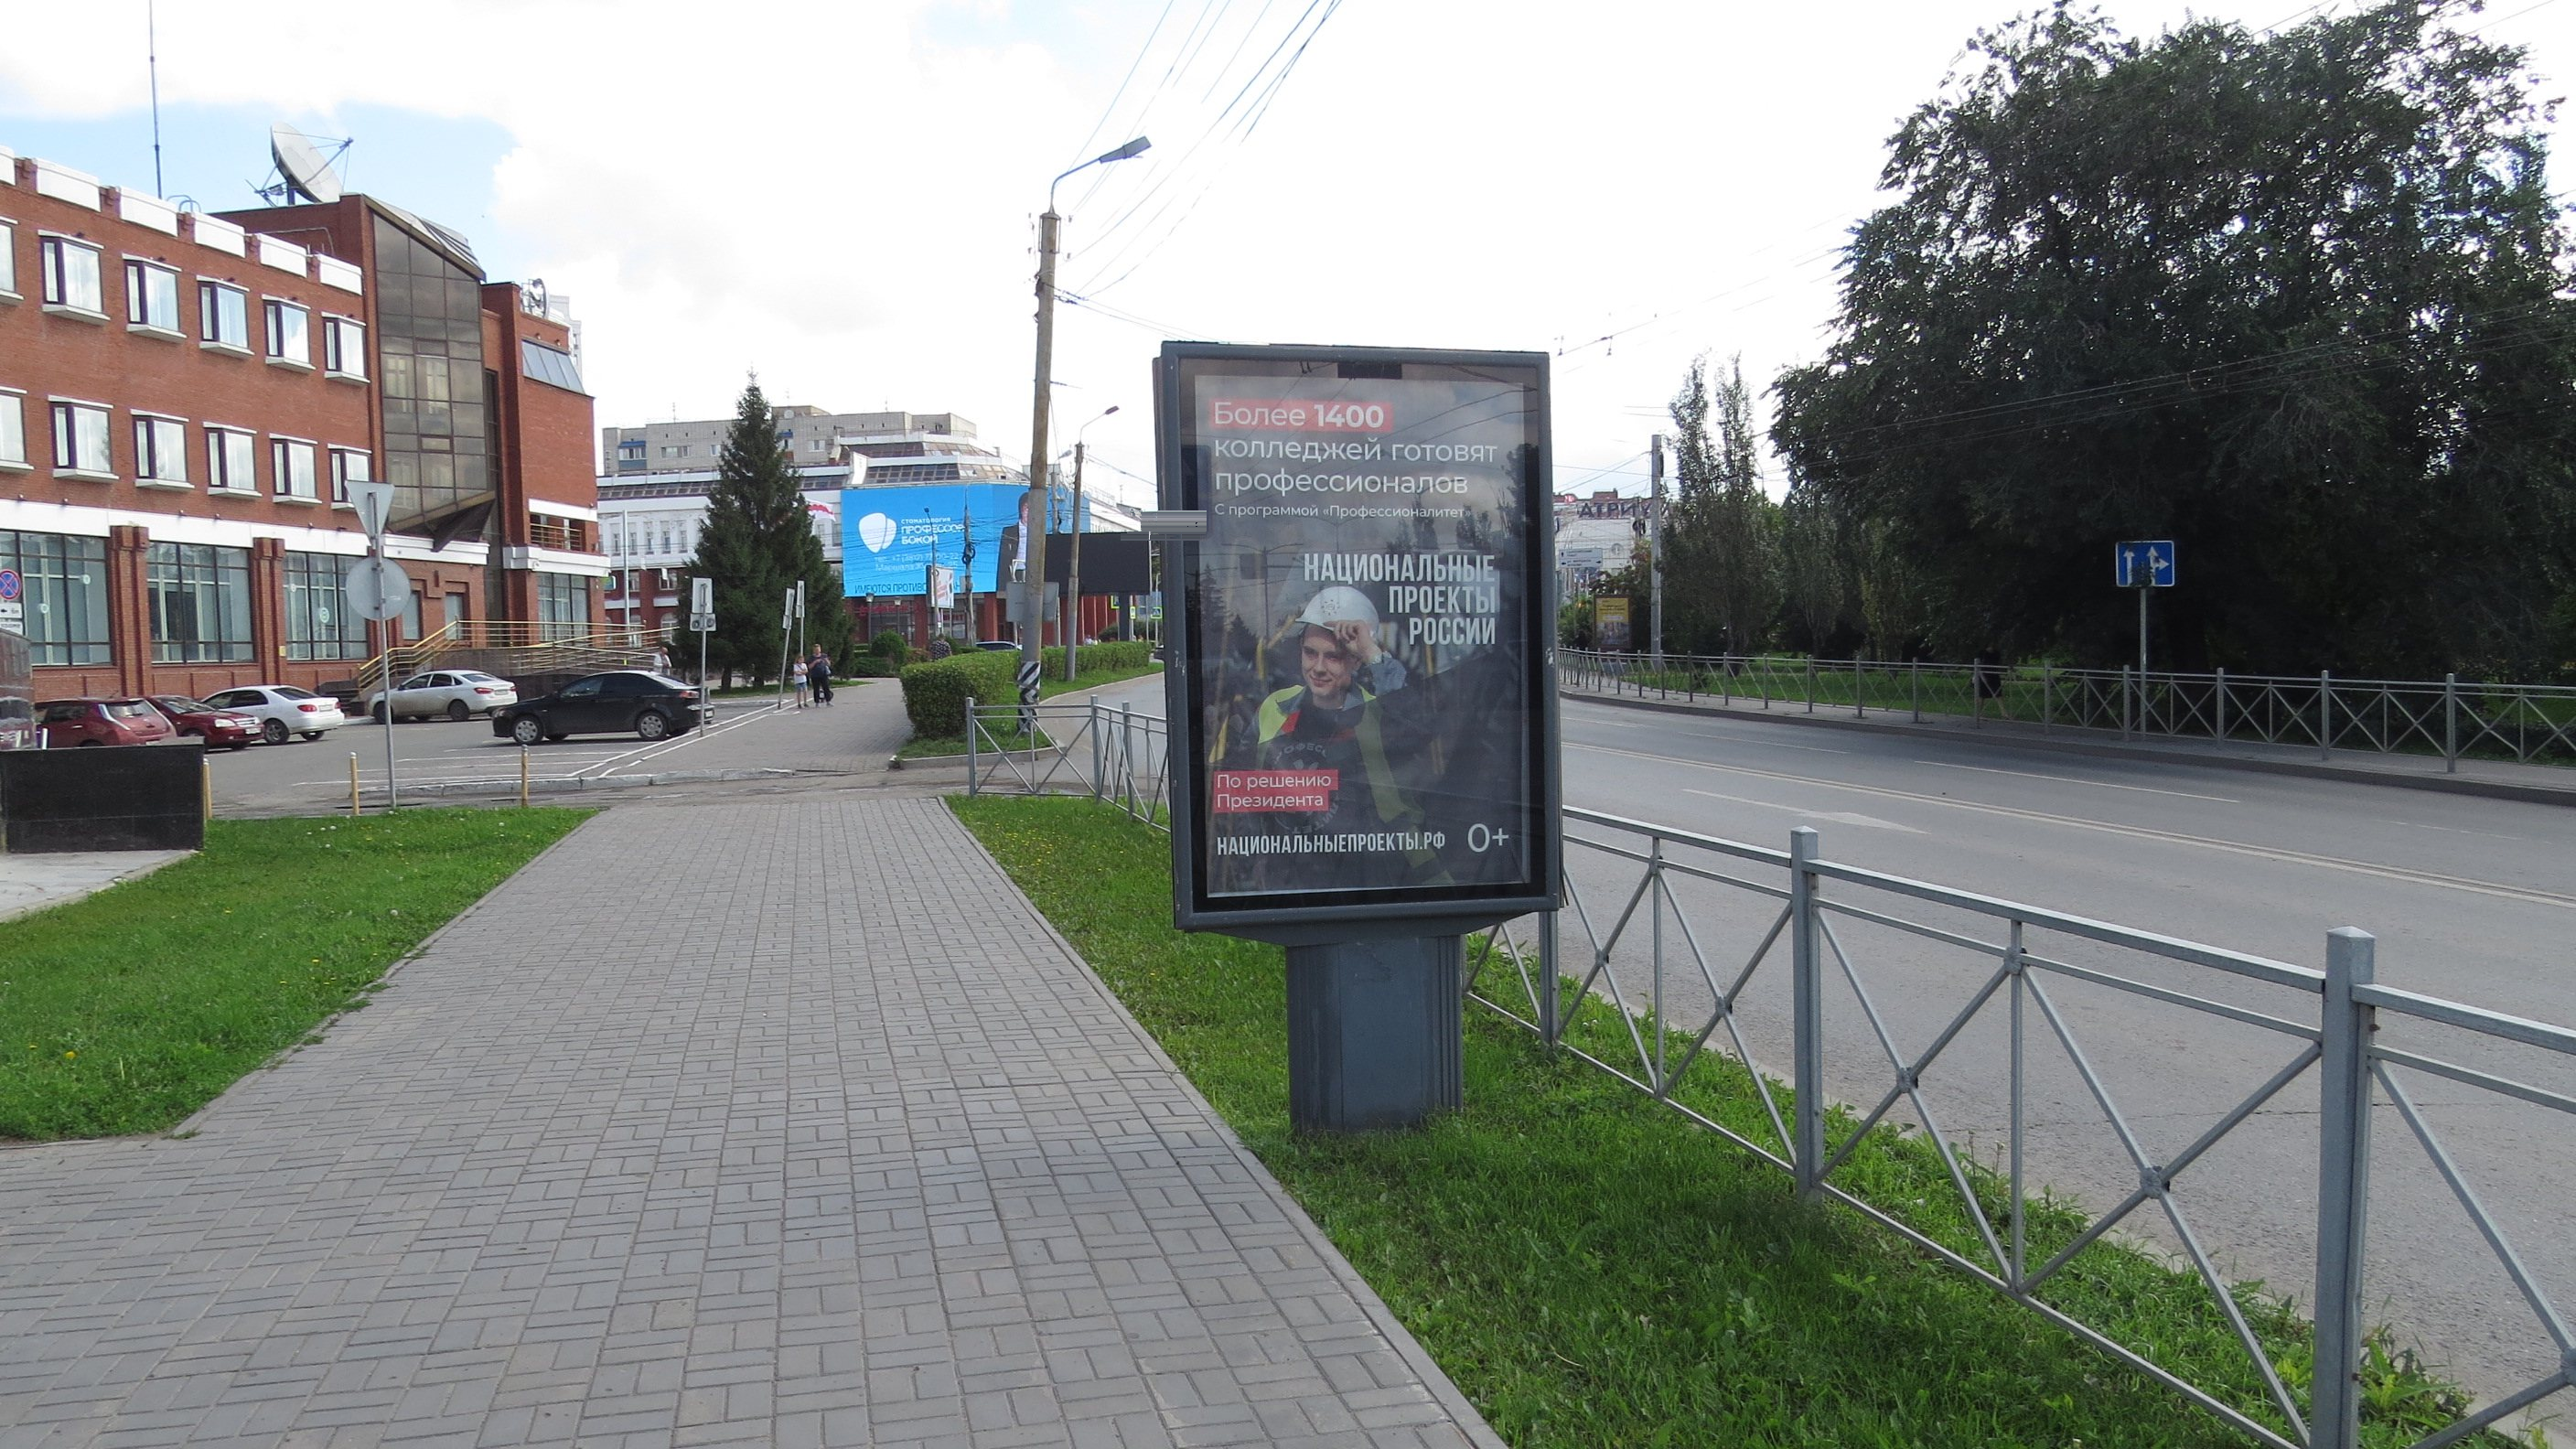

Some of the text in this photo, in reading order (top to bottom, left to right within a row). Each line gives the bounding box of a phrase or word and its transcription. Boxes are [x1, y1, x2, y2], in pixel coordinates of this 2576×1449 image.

[1215, 402, 1385, 428] Более 1400
[1215, 437, 1497, 462] колледжей готовят
[1215, 468, 1468, 497] профессионалов
[1215, 504, 1471, 520] С программой «Профессионалитет»
[1579, 499, 1672, 519] АТРИУ
[1304, 553, 1496, 585] НАЦИОНАЛЬНЫЕ
[854, 584, 891, 594] ИМЕЮТСЯ
[1389, 585, 1496, 614] ПРОЕКТЫ
[1409, 617, 1496, 645] РОССИИ
[1218, 774, 1332, 791] По решению
[1218, 794, 1324, 811] Президента
[1217, 823, 1509, 856] НАЦИОНАЛЬНЫЕПРОЕКТЫ.РФ 0+
